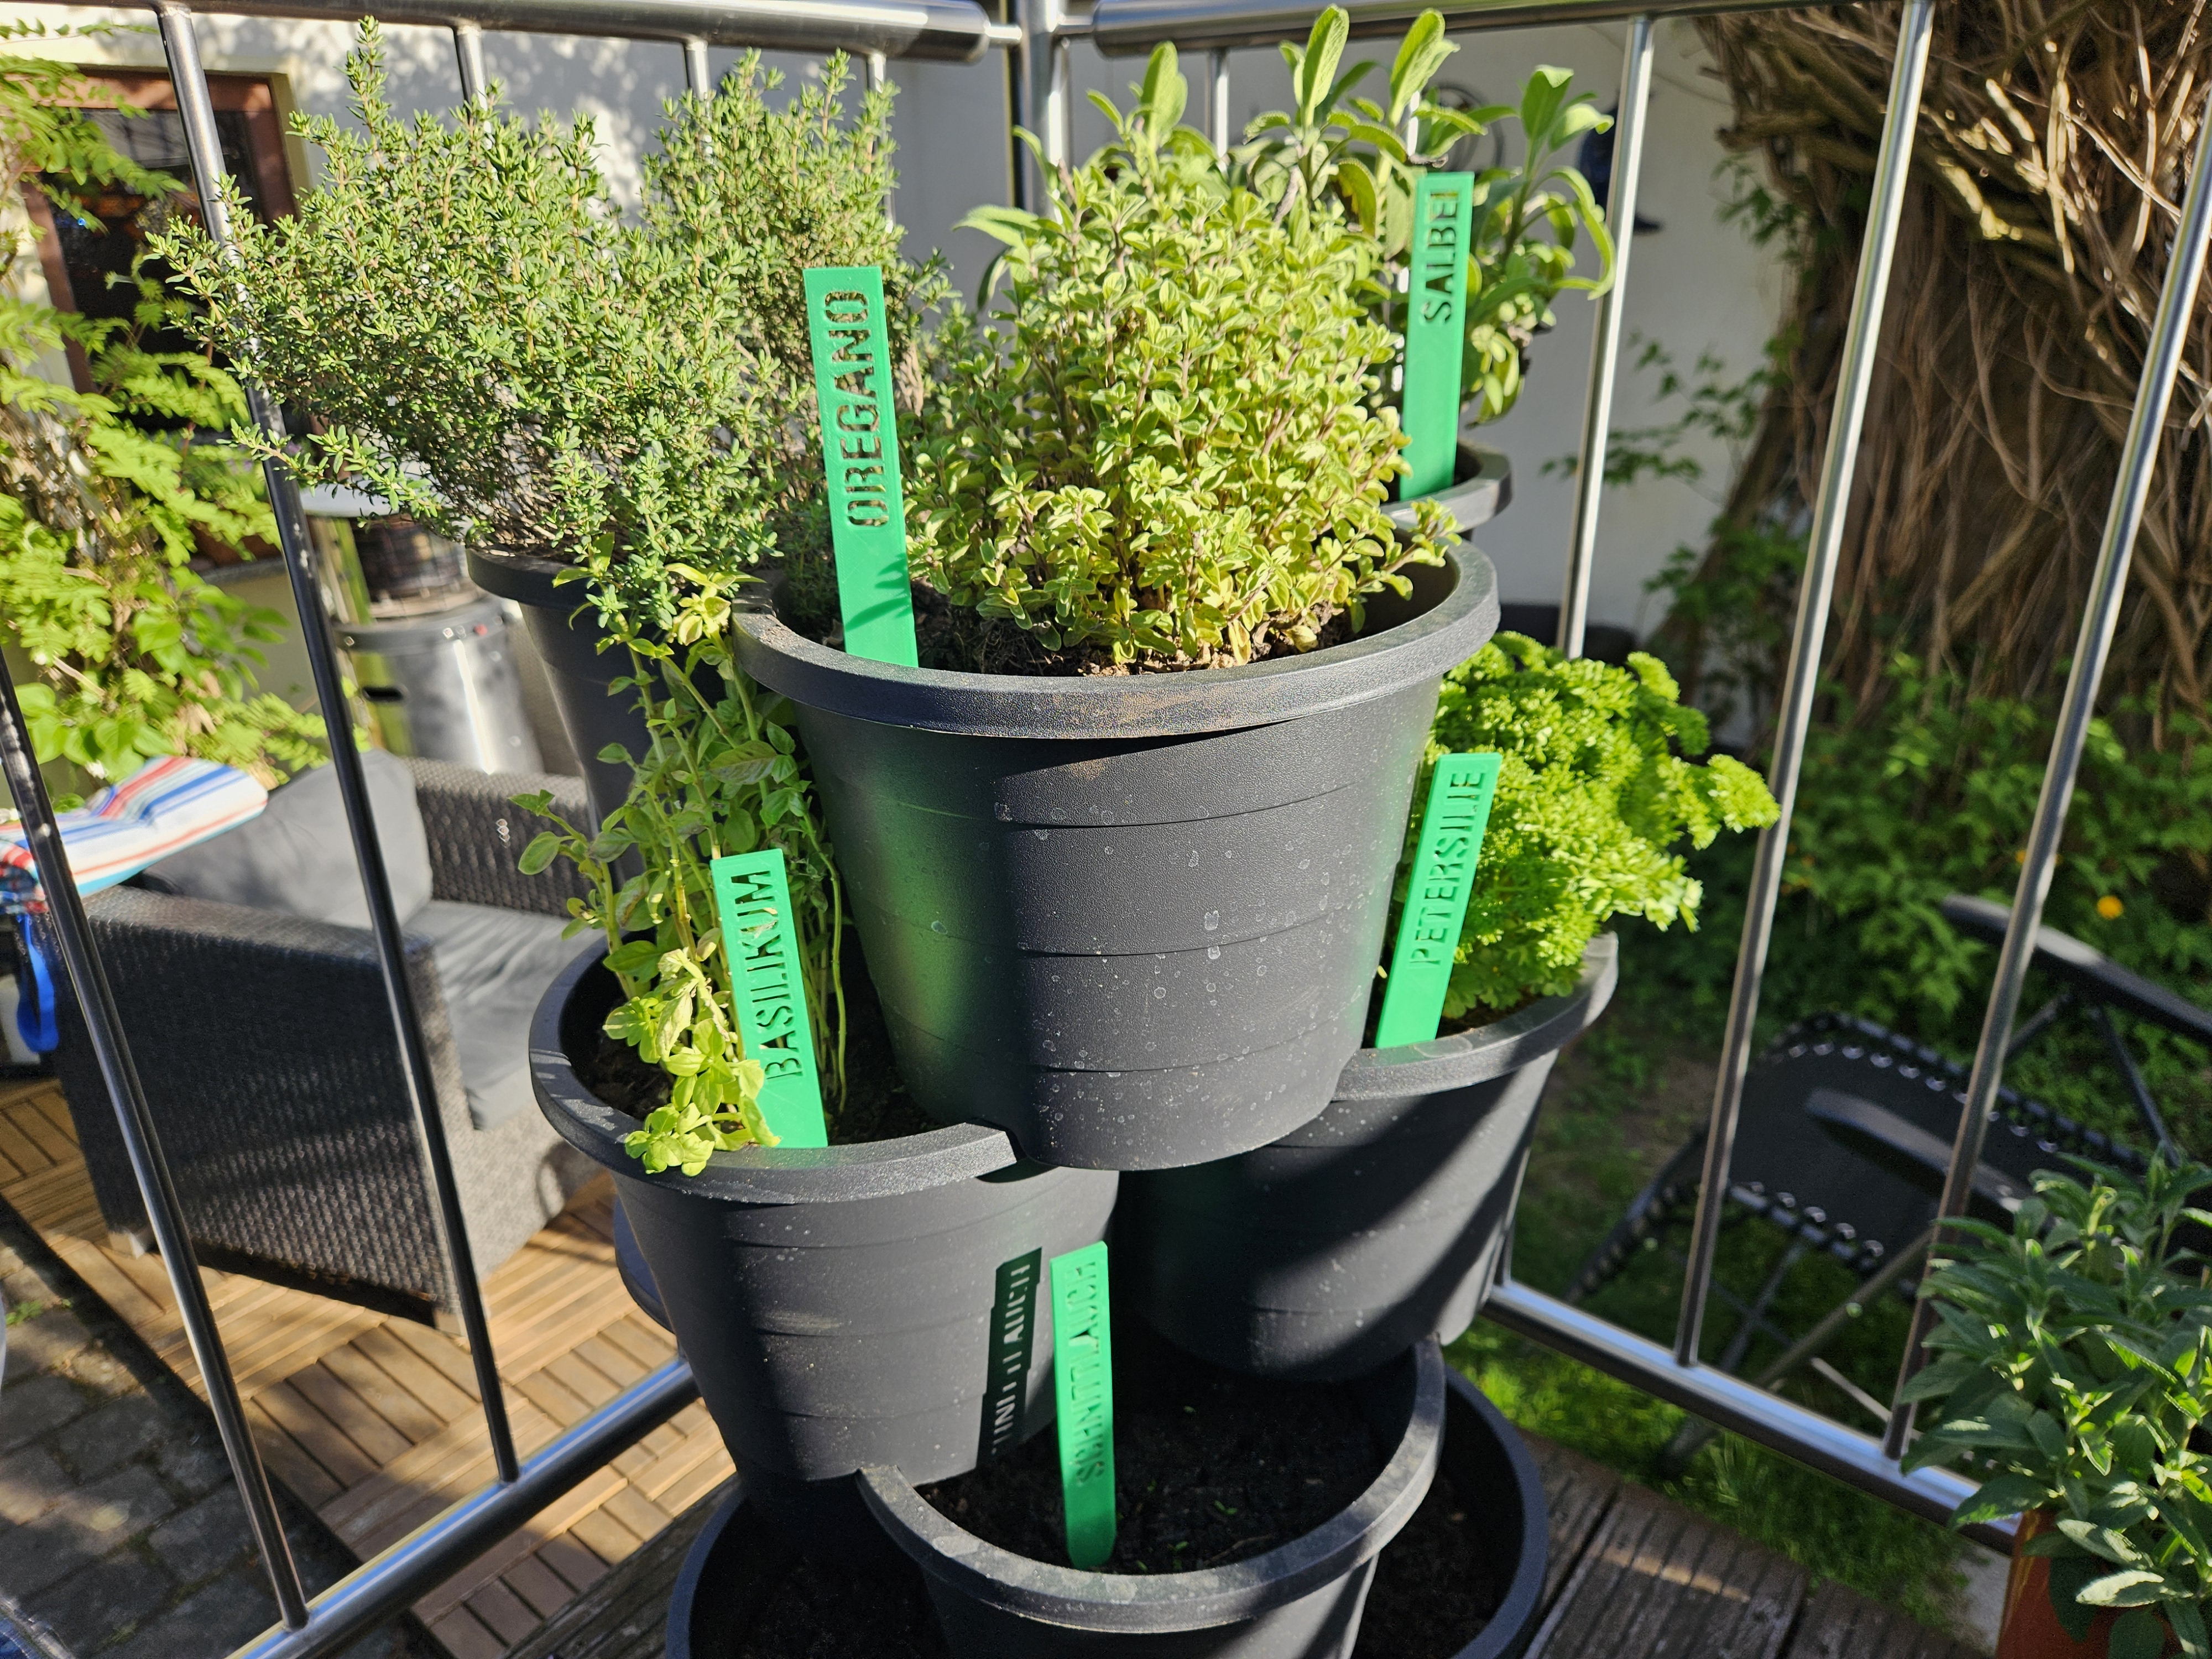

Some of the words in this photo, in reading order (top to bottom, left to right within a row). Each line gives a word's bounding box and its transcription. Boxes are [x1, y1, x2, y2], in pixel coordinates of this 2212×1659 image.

[1423, 190, 1459, 322] SALBEI
[822, 290, 889, 527] OREGANO
[730, 869, 804, 1081] BASILIKUM
[1409, 771, 1486, 967] PETERSILIE
[1066, 1260, 1105, 1486] SCHNITTLAUCH
